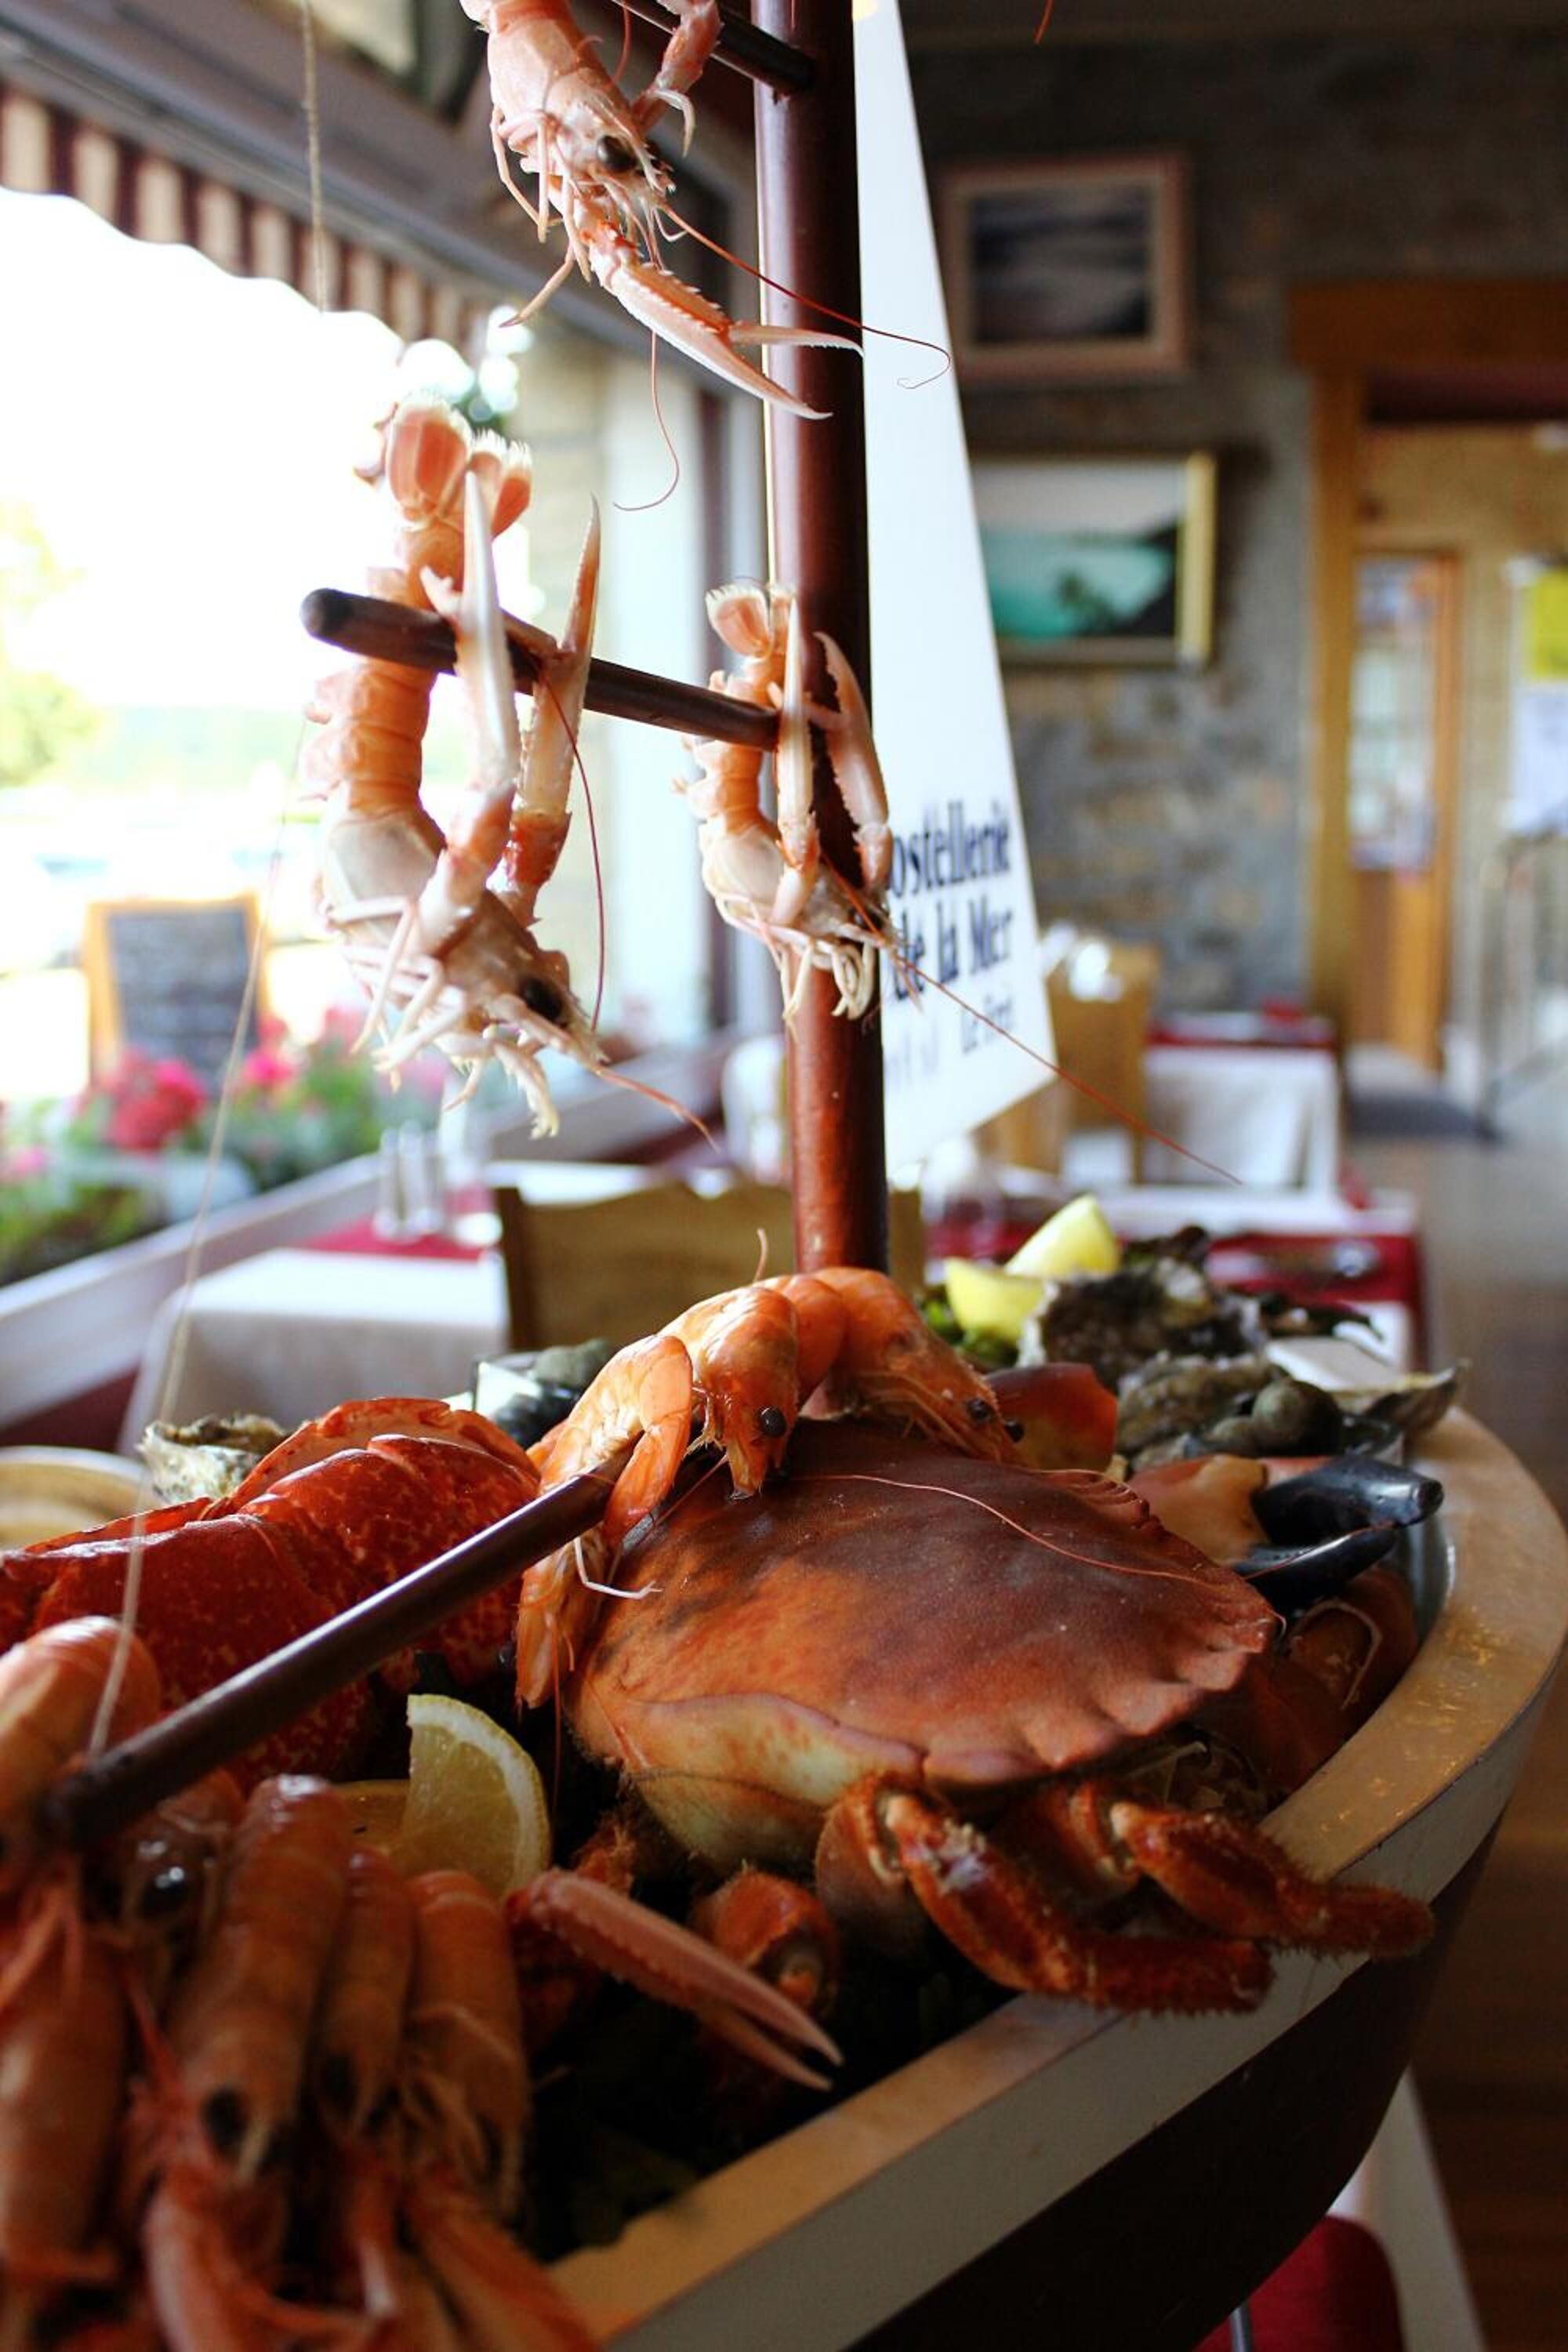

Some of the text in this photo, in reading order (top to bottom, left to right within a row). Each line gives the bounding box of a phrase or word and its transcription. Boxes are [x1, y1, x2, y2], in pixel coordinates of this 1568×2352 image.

[891, 800, 1010, 898] ostellerie
[935, 901, 959, 985] la
[967, 894, 1013, 975] Mer
